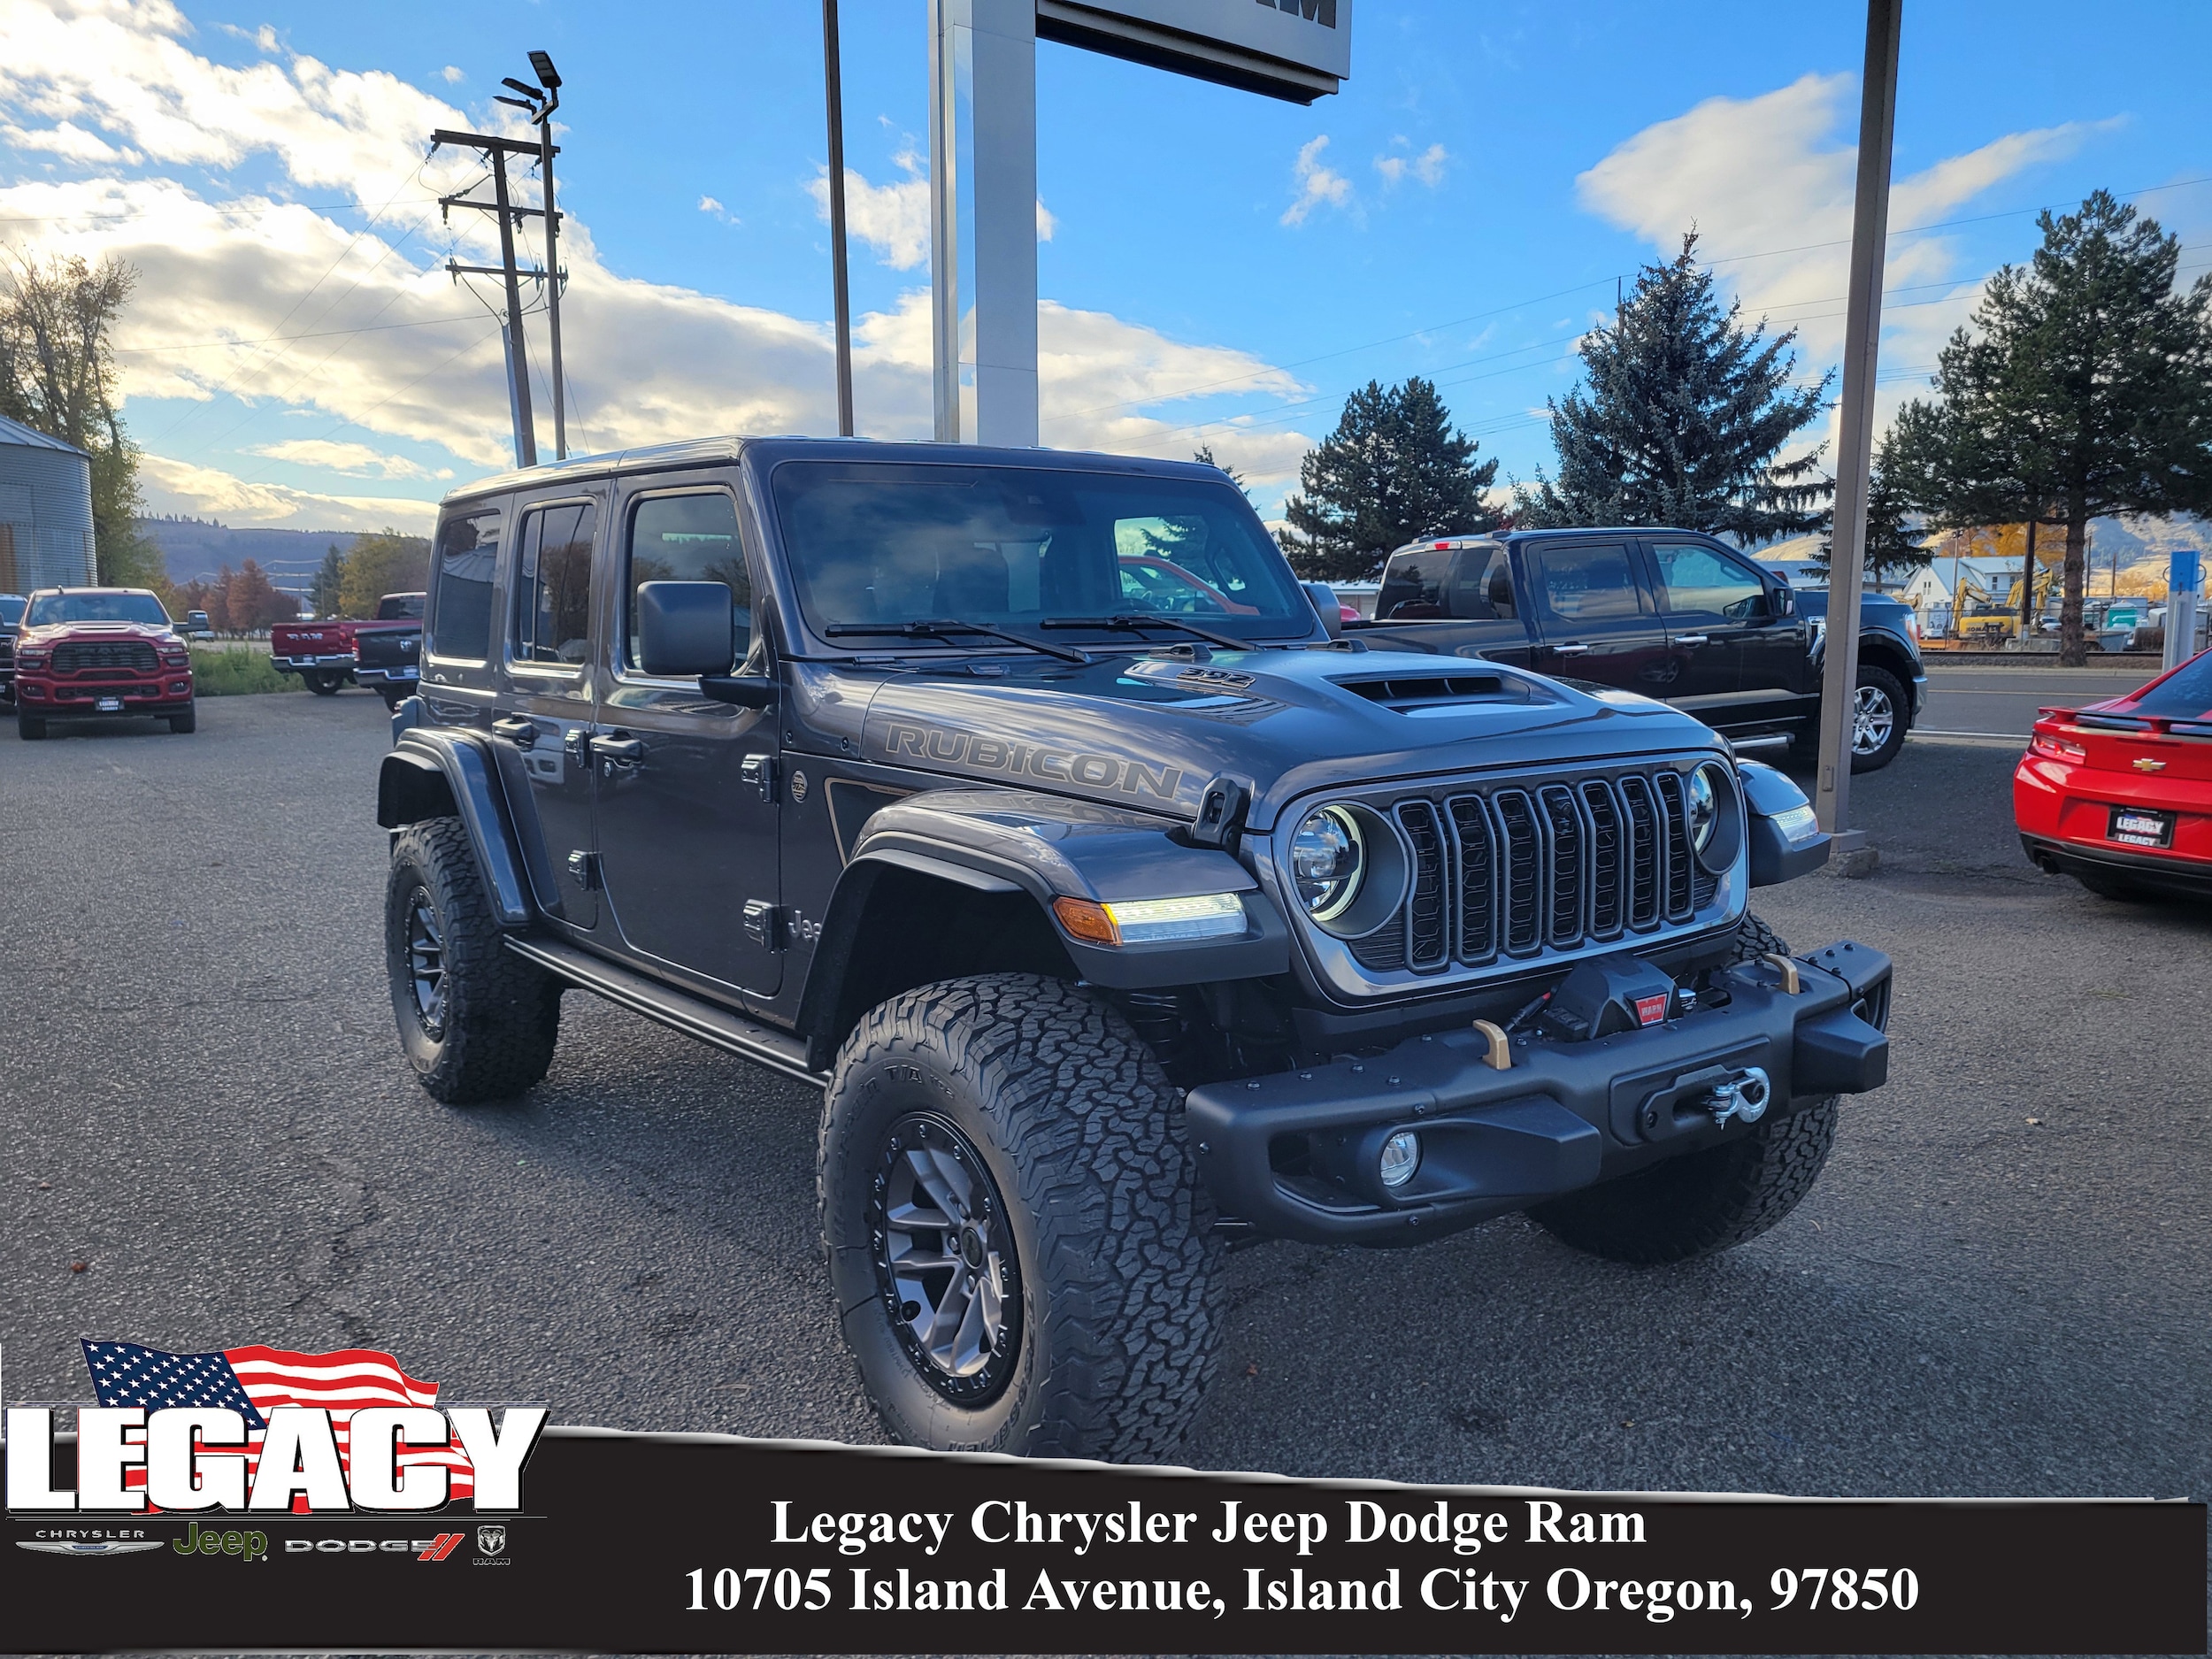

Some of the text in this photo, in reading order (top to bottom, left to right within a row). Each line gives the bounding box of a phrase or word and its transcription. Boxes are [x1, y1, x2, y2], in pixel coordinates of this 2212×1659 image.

[287, 632, 324, 641] RAM
[1176, 666, 1256, 689] 392
[885, 724, 1183, 797] RUBICON
[2116, 816, 2165, 834] LEGACY
[2117, 833, 2156, 847] LEGACY
[787, 910, 822, 943] Jee
[1641, 1002, 1663, 1017] WARN
